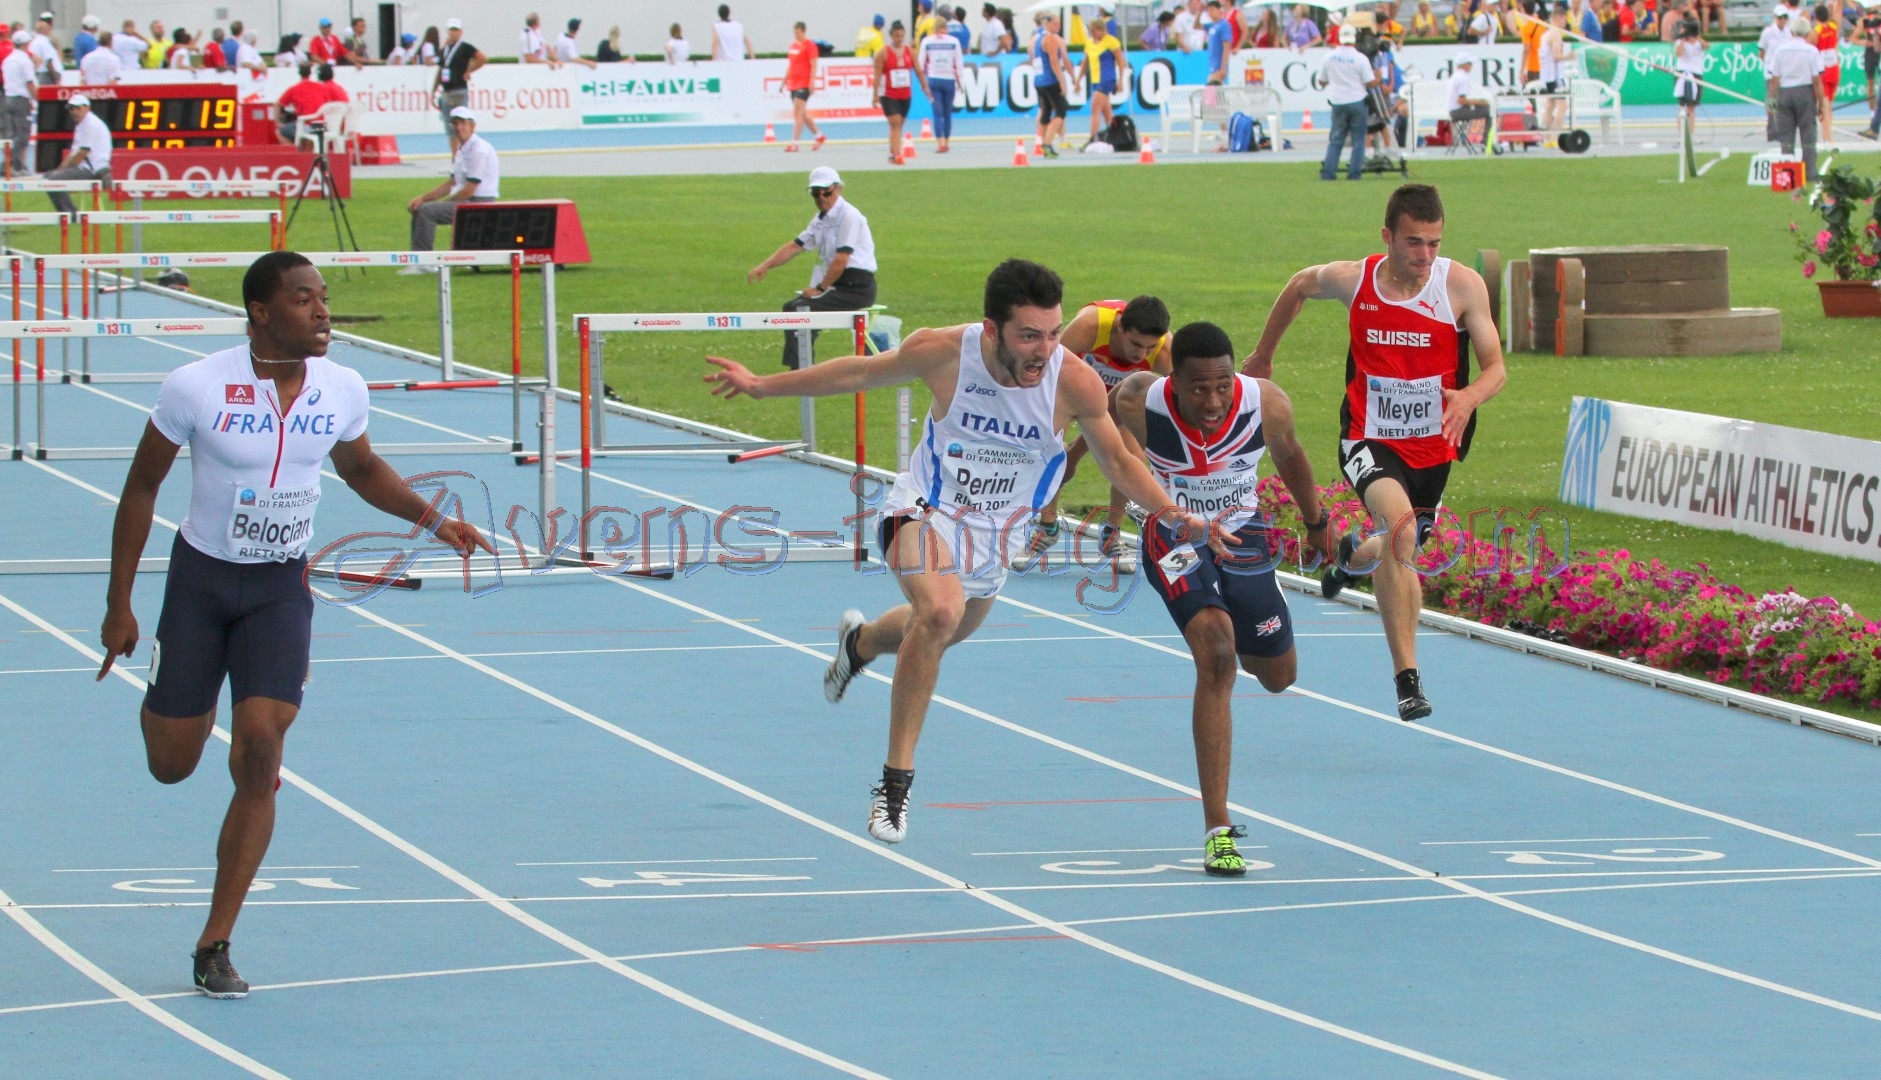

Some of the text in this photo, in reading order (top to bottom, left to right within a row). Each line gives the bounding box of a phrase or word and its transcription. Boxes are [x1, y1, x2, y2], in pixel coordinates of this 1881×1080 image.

[1633, 47, 1718, 76] Gruo
[581, 77, 721, 96] CREATIVE
[356, 83, 570, 119] rietiming.com
[1753, 160, 1771, 181] 18
[181, 165, 330, 198] OMEGA
[1366, 304, 1379, 312] UBS
[1367, 329, 1432, 347] SUISSE
[975, 386, 998, 397] asics
[1392, 381, 1431, 390] CAMMINO
[1394, 385, 1440, 395] FRANCESCO
[1378, 396, 1432, 424] Meyer
[225, 413, 336, 435] FRANCE
[961, 412, 1041, 440] ITALIA
[1377, 426, 1430, 437] RIETI 2013
[966, 453, 1035, 466] DI FRANCESCO
[977, 448, 1026, 458] CAMMINO
[1352, 457, 1367, 476] 2
[957, 467, 1018, 496] Derini
[1200, 474, 1243, 486] CAMMINO
[1611, 434, 1880, 545] EUROPEAN ATHLETICS
[259, 494, 320, 508] DI FRANCESCO
[271, 488, 314, 500] CAMMINO
[231, 513, 311, 546] Belocian
[239, 547, 275, 559] RIETI
[1170, 553, 1189, 573] 3
